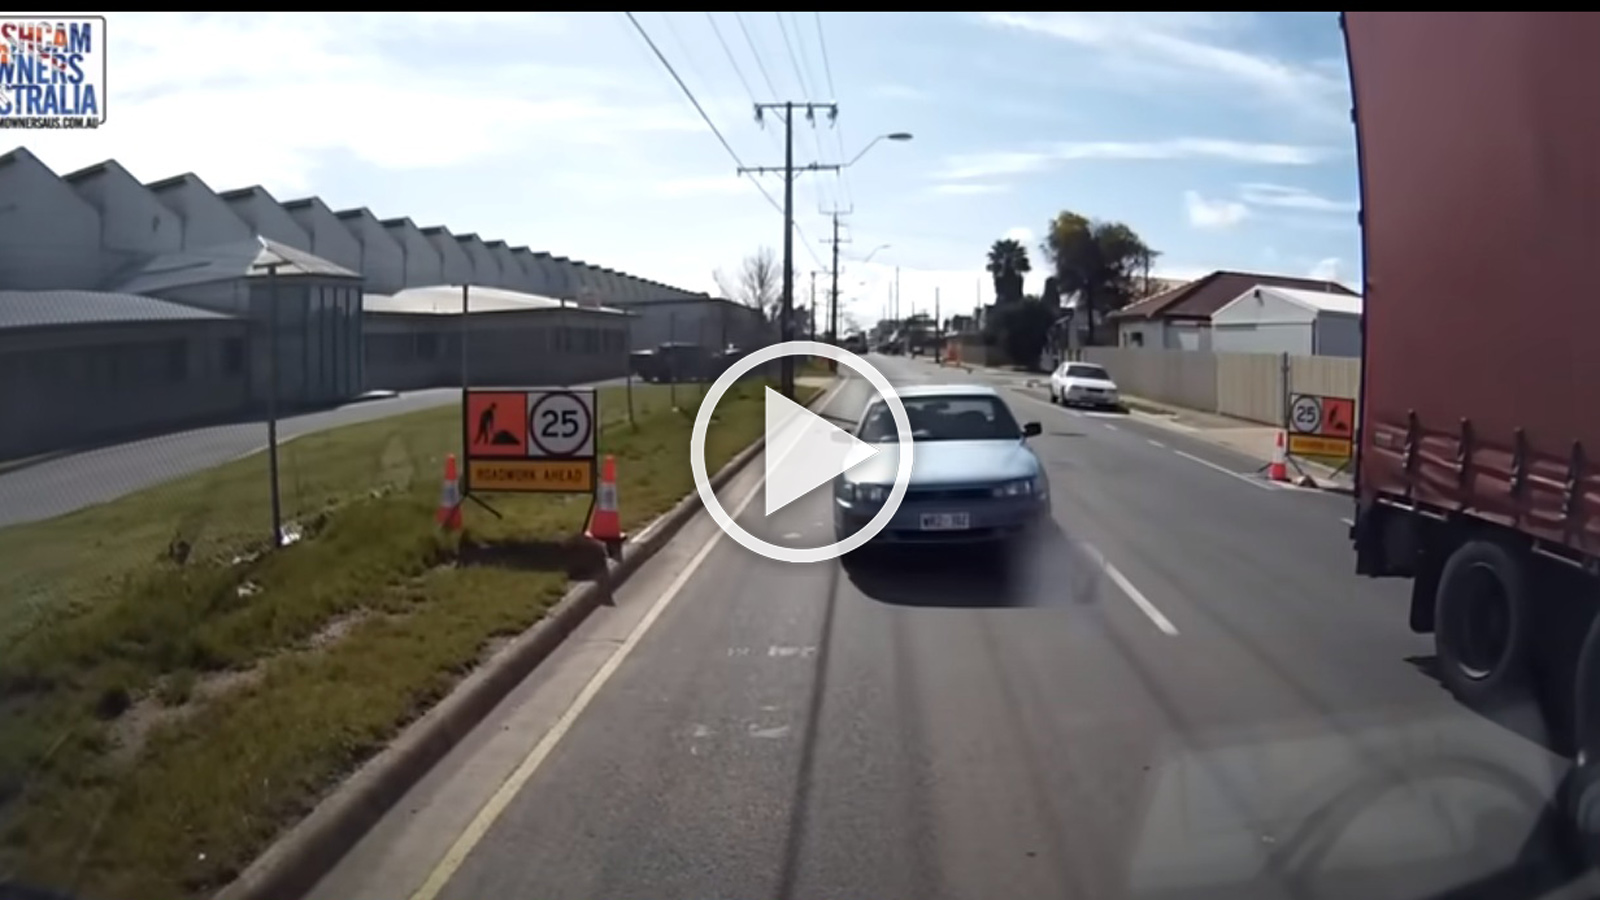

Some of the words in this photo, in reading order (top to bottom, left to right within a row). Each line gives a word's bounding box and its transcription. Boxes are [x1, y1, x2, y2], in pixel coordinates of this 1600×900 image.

[1296, 405, 1316, 423] 25
[541, 410, 579, 438] 25
[476, 468, 536, 482] ROADWORK
[543, 468, 583, 483] AHEAD
